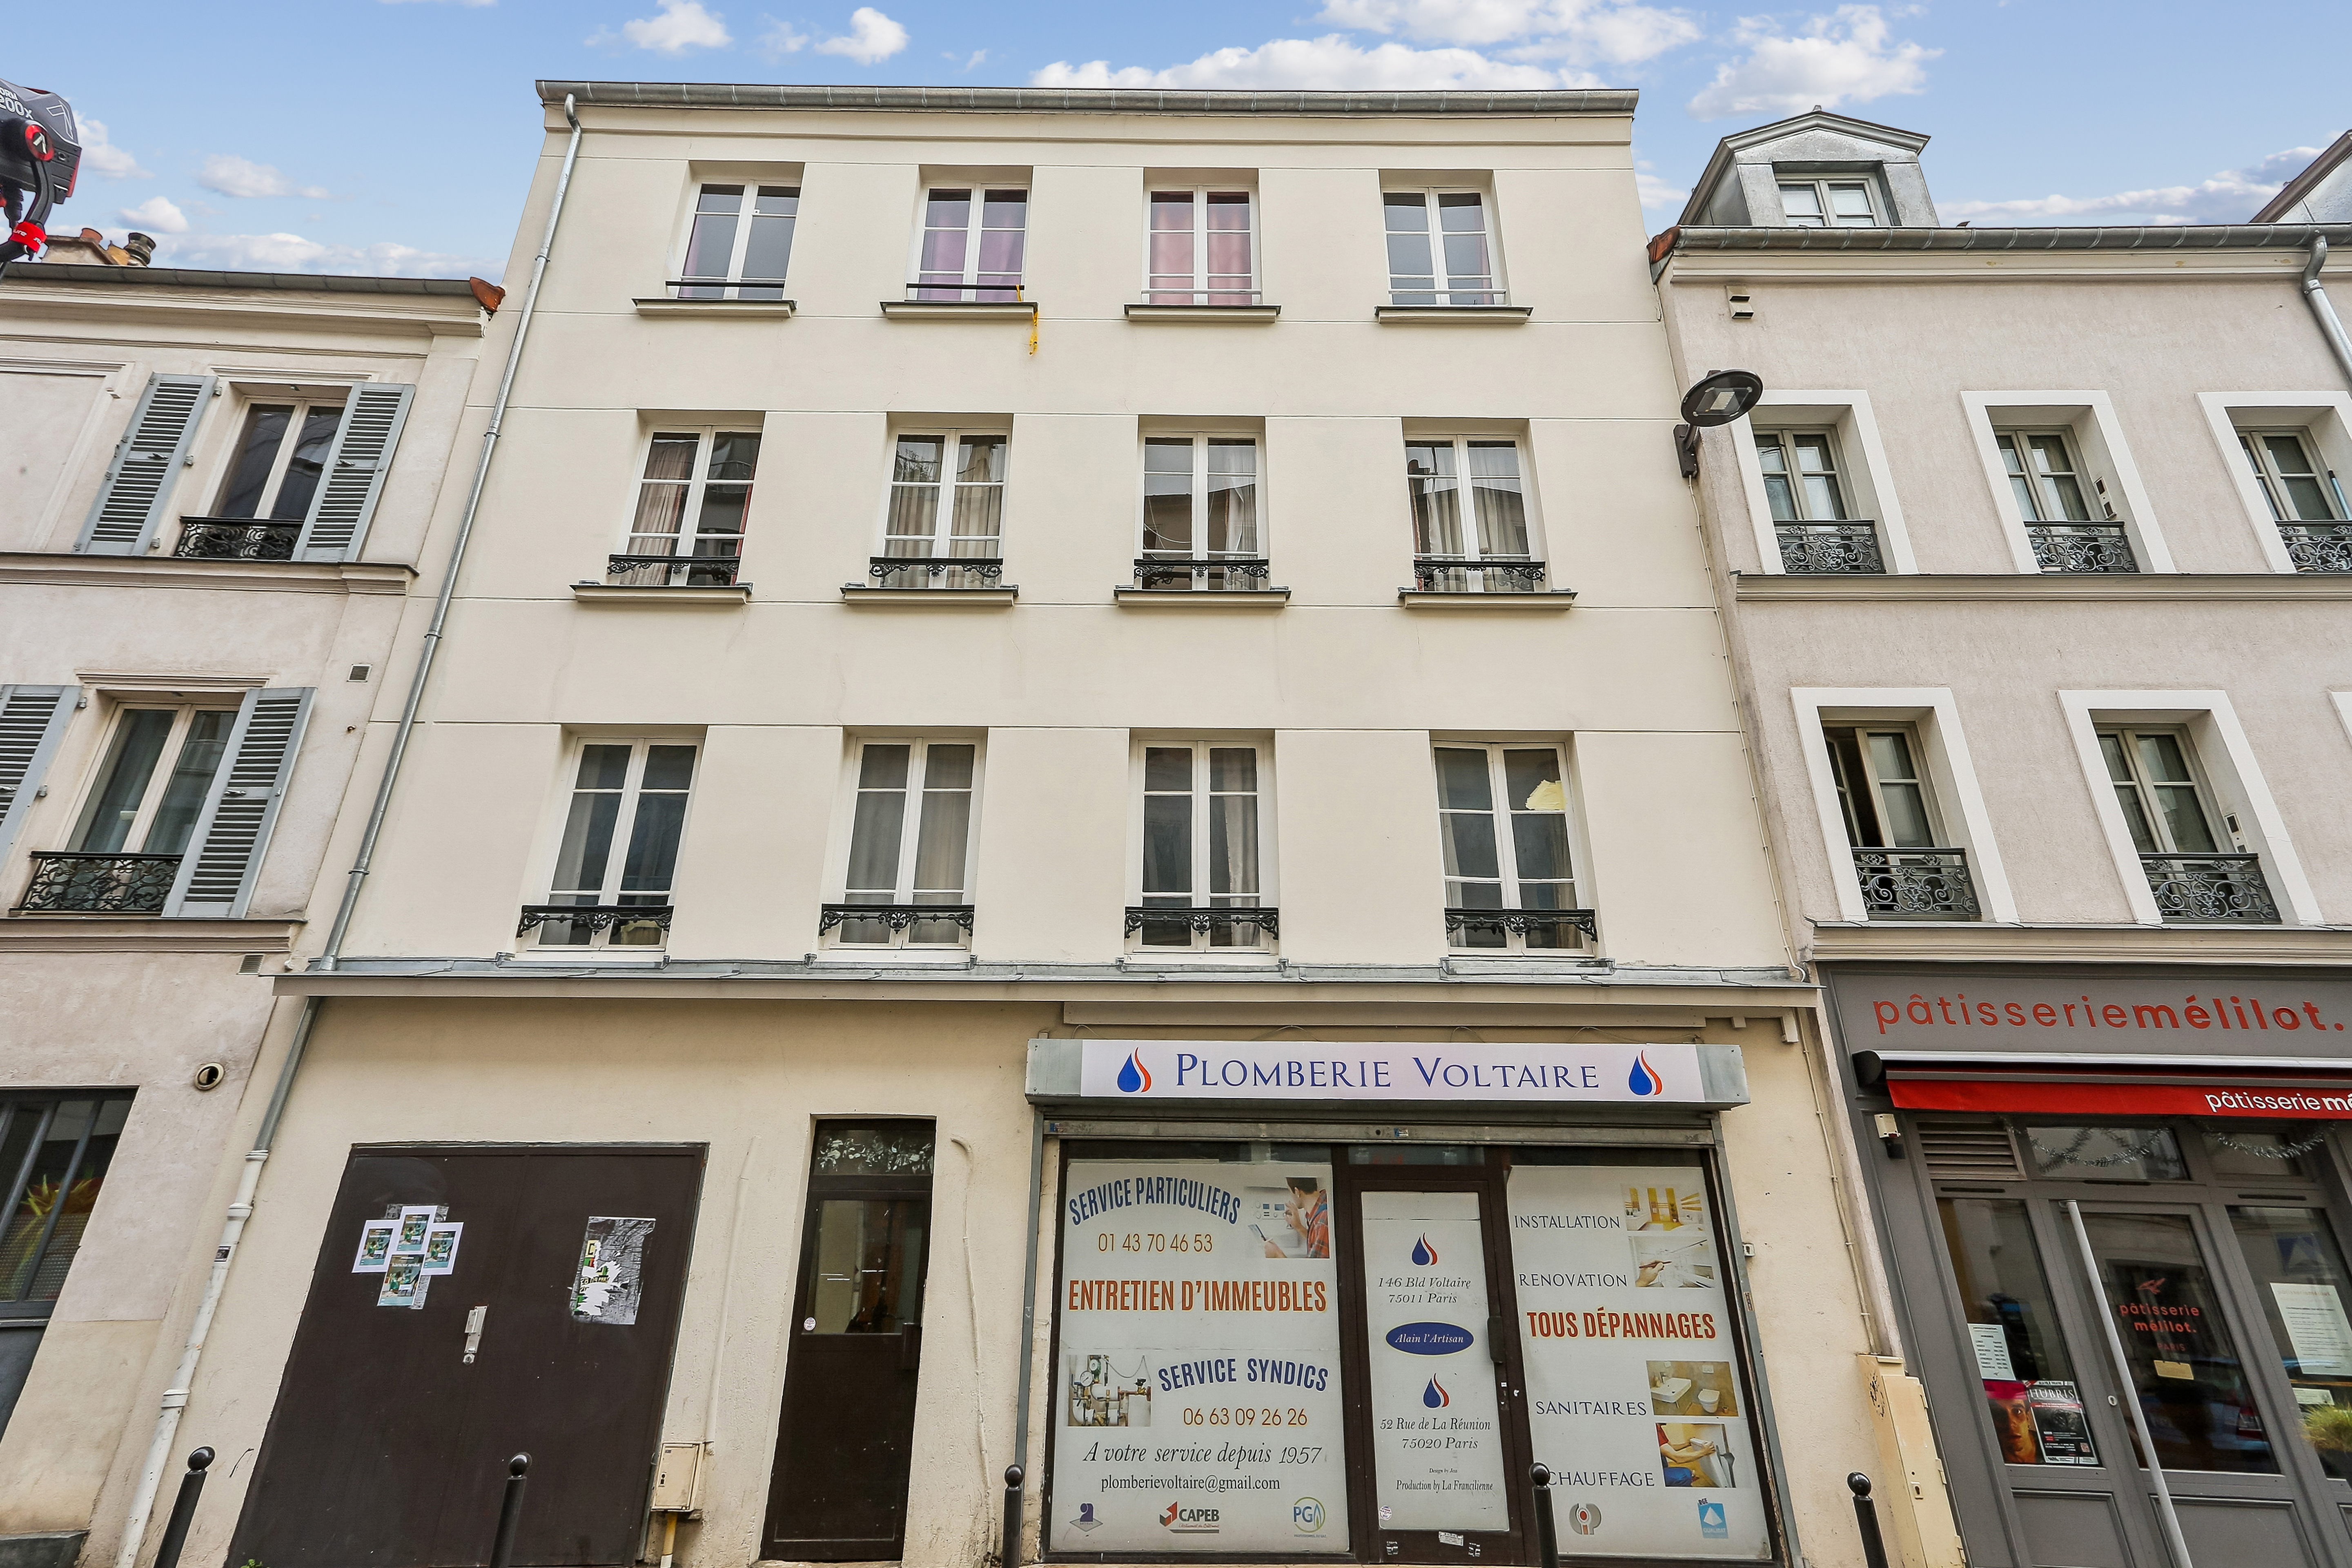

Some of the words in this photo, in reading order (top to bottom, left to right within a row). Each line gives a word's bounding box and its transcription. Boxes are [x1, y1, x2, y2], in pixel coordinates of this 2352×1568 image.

[1176, 1053, 1391, 1088] PLOMBERIE
[1411, 1057, 1600, 1089] VOLTAIRE
[2205, 1091, 2321, 1112] pâtisserie
[2321, 1093, 2352, 1111] m
[1068, 1178, 1132, 1226] SERVICE
[1135, 1176, 1241, 1225] PARTICULIERS
[1514, 1215, 1620, 1229] INSTALLATION
[1098, 1233, 1115, 1252] 01
[1122, 1233, 1141, 1252] 43
[1147, 1233, 1165, 1252] 70
[1170, 1233, 1189, 1252] 46
[1193, 1233, 1213, 1252] 53
[1378, 1278, 1402, 1288] 146
[1405, 1277, 1425, 1288] Bld
[1428, 1277, 1471, 1289] Voltaire
[1519, 1273, 1628, 1287] RENOVATION
[1069, 1280, 1174, 1311] ENTRETIEN
[1388, 1294, 1423, 1303] 75011
[1428, 1293, 1457, 1303] Paris
[2119, 1303, 2200, 1316] pâtisserie
[1526, 1311, 1579, 1338] TOUS
[1583, 1306, 1717, 1339] DÉPANNAGES
[2134, 1319, 2197, 1333] mélilot.
[1395, 1334, 1421, 1343] Alain
[1158, 1358, 1236, 1392] SERVICE
[1247, 1358, 1329, 1392] SYNDICS
[2029, 1389, 2075, 1399] HUBRIS
[1535, 1401, 1647, 1416] SANITAIRES
[1183, 1407, 1204, 1426] 06
[1209, 1407, 1229, 1426] 63
[1235, 1407, 1255, 1426] 09
[1261, 1407, 1282, 1426] 26
[1287, 1407, 1308, 1426] 26
[1380, 1419, 1393, 1430] 52
[1396, 1418, 1416, 1430] Rue
[1419, 1418, 1430, 1430] de
[1432, 1418, 1447, 1430] La
[1450, 1417, 1491, 1430] Réunion
[1402, 1438, 1442, 1449] 75020
[1445, 1437, 1479, 1449] Paris
[1082, 1441, 1098, 1462] A
[1104, 1443, 1147, 1463] votre
[1154, 1441, 1211, 1463] service
[1217, 1442, 1272, 1470] depuis
[1278, 1447, 1322, 1465] 1957
[1101, 1475, 1281, 1493] plomberievoltaire@gmail.com
[1396, 1479, 1431, 1490] Production
[1433, 1479, 1440, 1491] by
[1442, 1480, 1451, 1490] La
[1454, 1480, 1493, 1490] Francilienne
[1549, 1471, 1655, 1486] CHAUFFAGE
[1178, 1508, 1220, 1522] CAPEB
